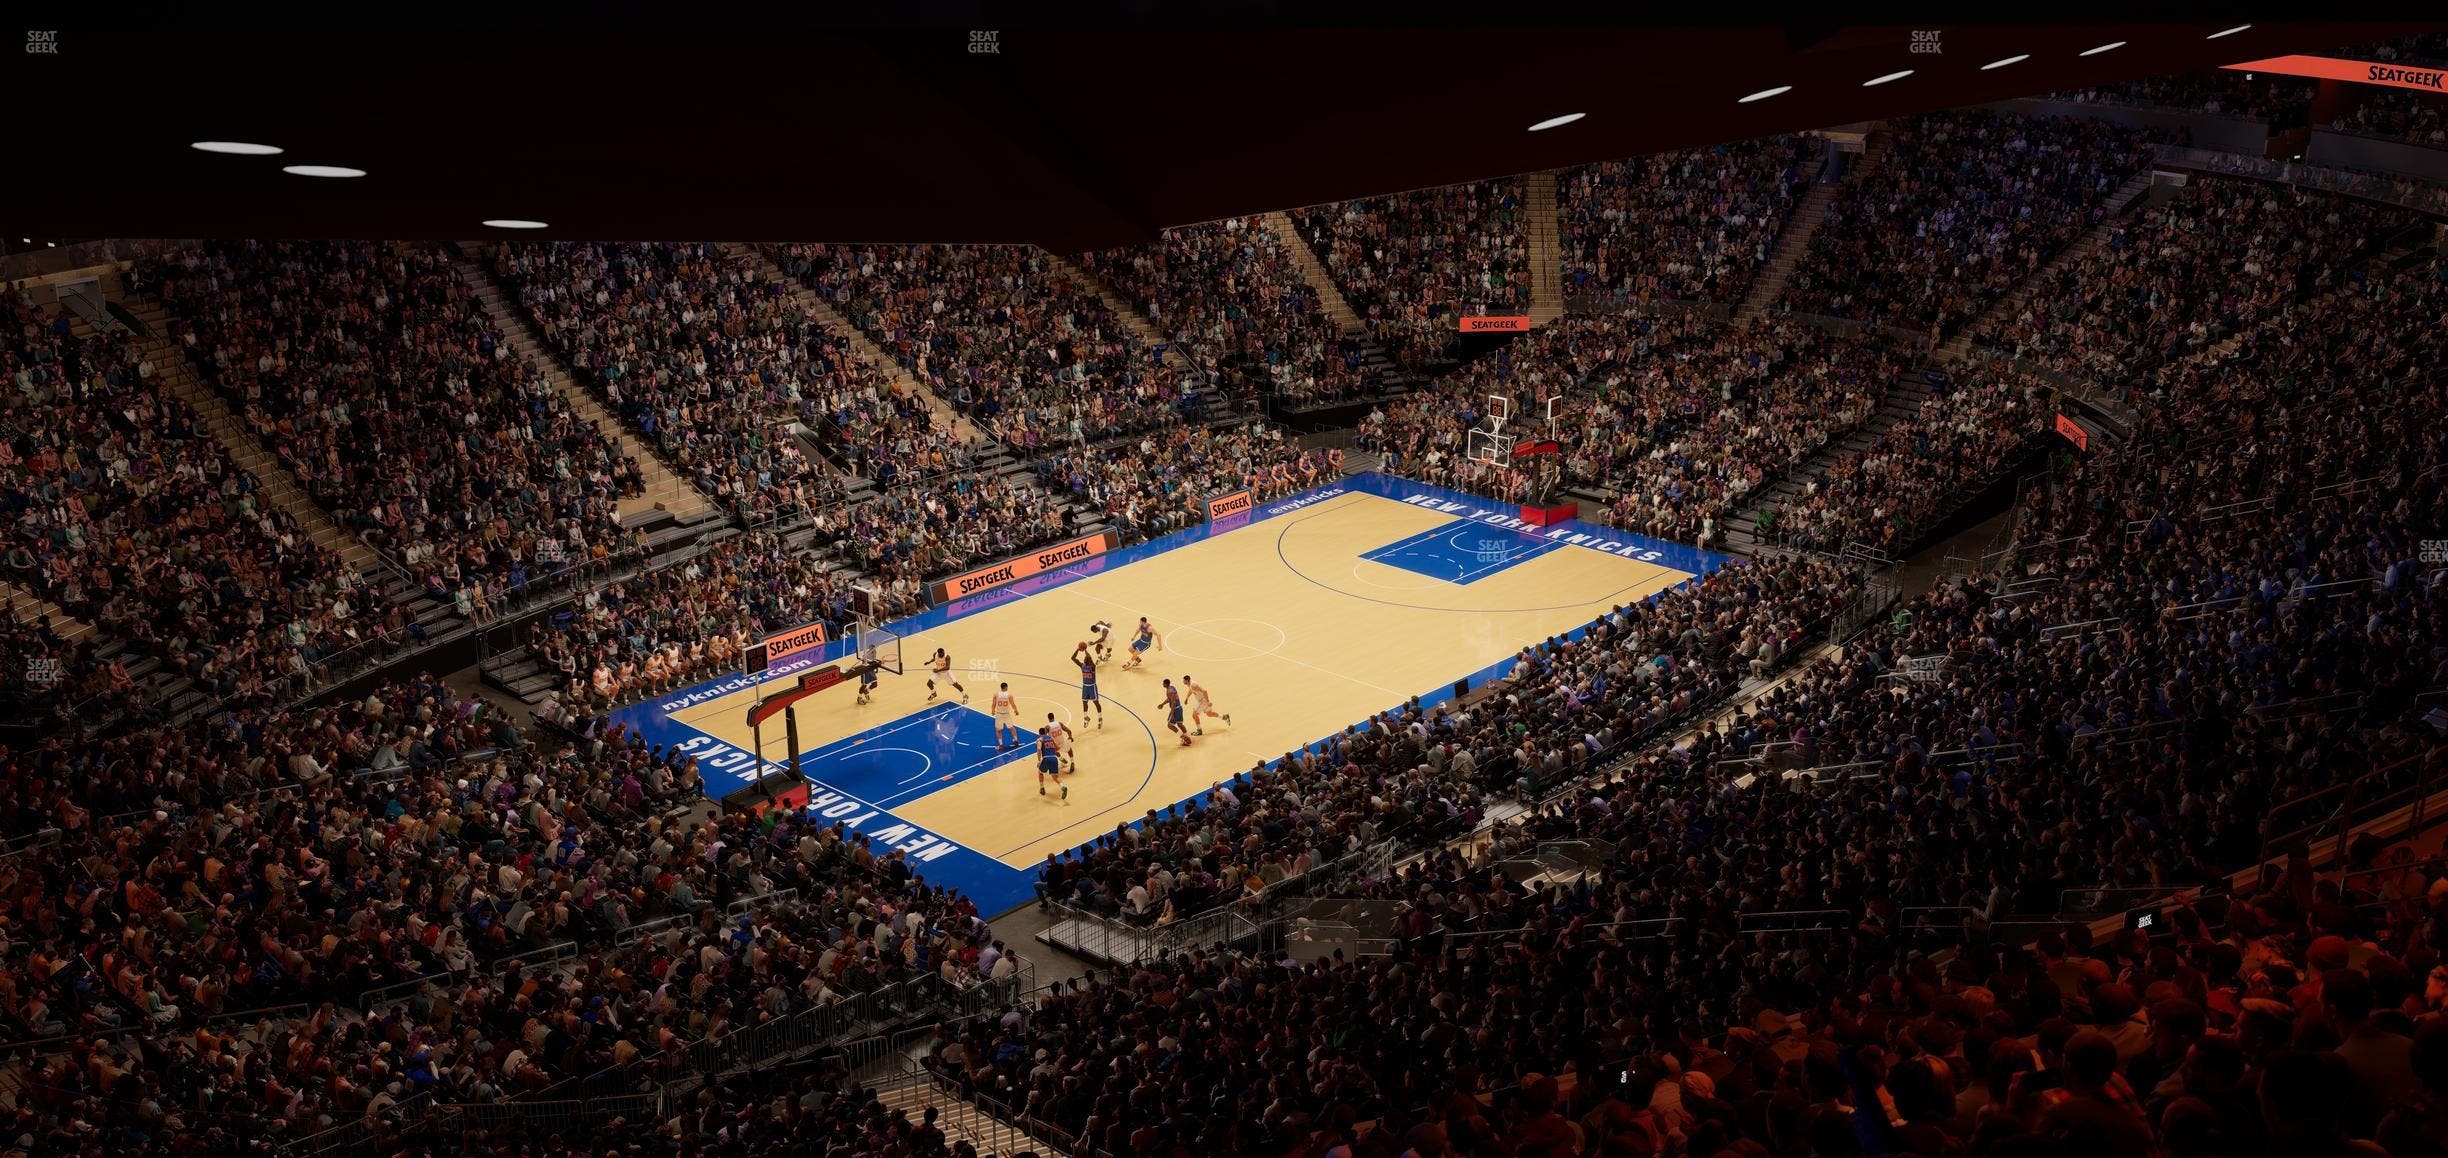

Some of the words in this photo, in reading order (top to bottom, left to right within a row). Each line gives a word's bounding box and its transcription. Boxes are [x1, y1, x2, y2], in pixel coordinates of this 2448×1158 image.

[2368, 65, 2445, 89] SEATGEEK
[1471, 320, 1518, 329] SEATGEEK
[1212, 495, 1250, 517] SEATGEEK
[1268, 489, 1344, 514] @nyknicks
[1401, 494, 1467, 512] NEW
[1469, 509, 1541, 532] YORK
[1544, 528, 1663, 561] KNICKS
[960, 565, 1015, 594] SEATGEEK
[1039, 542, 1091, 569] SEATGEEK
[769, 628, 822, 656] SEATGEEK
[662, 659, 812, 711] nyknicks.com
[808, 671, 837, 686] SEATGEEK
[674, 736, 778, 782] NICKS
[868, 823, 959, 862] NEW
